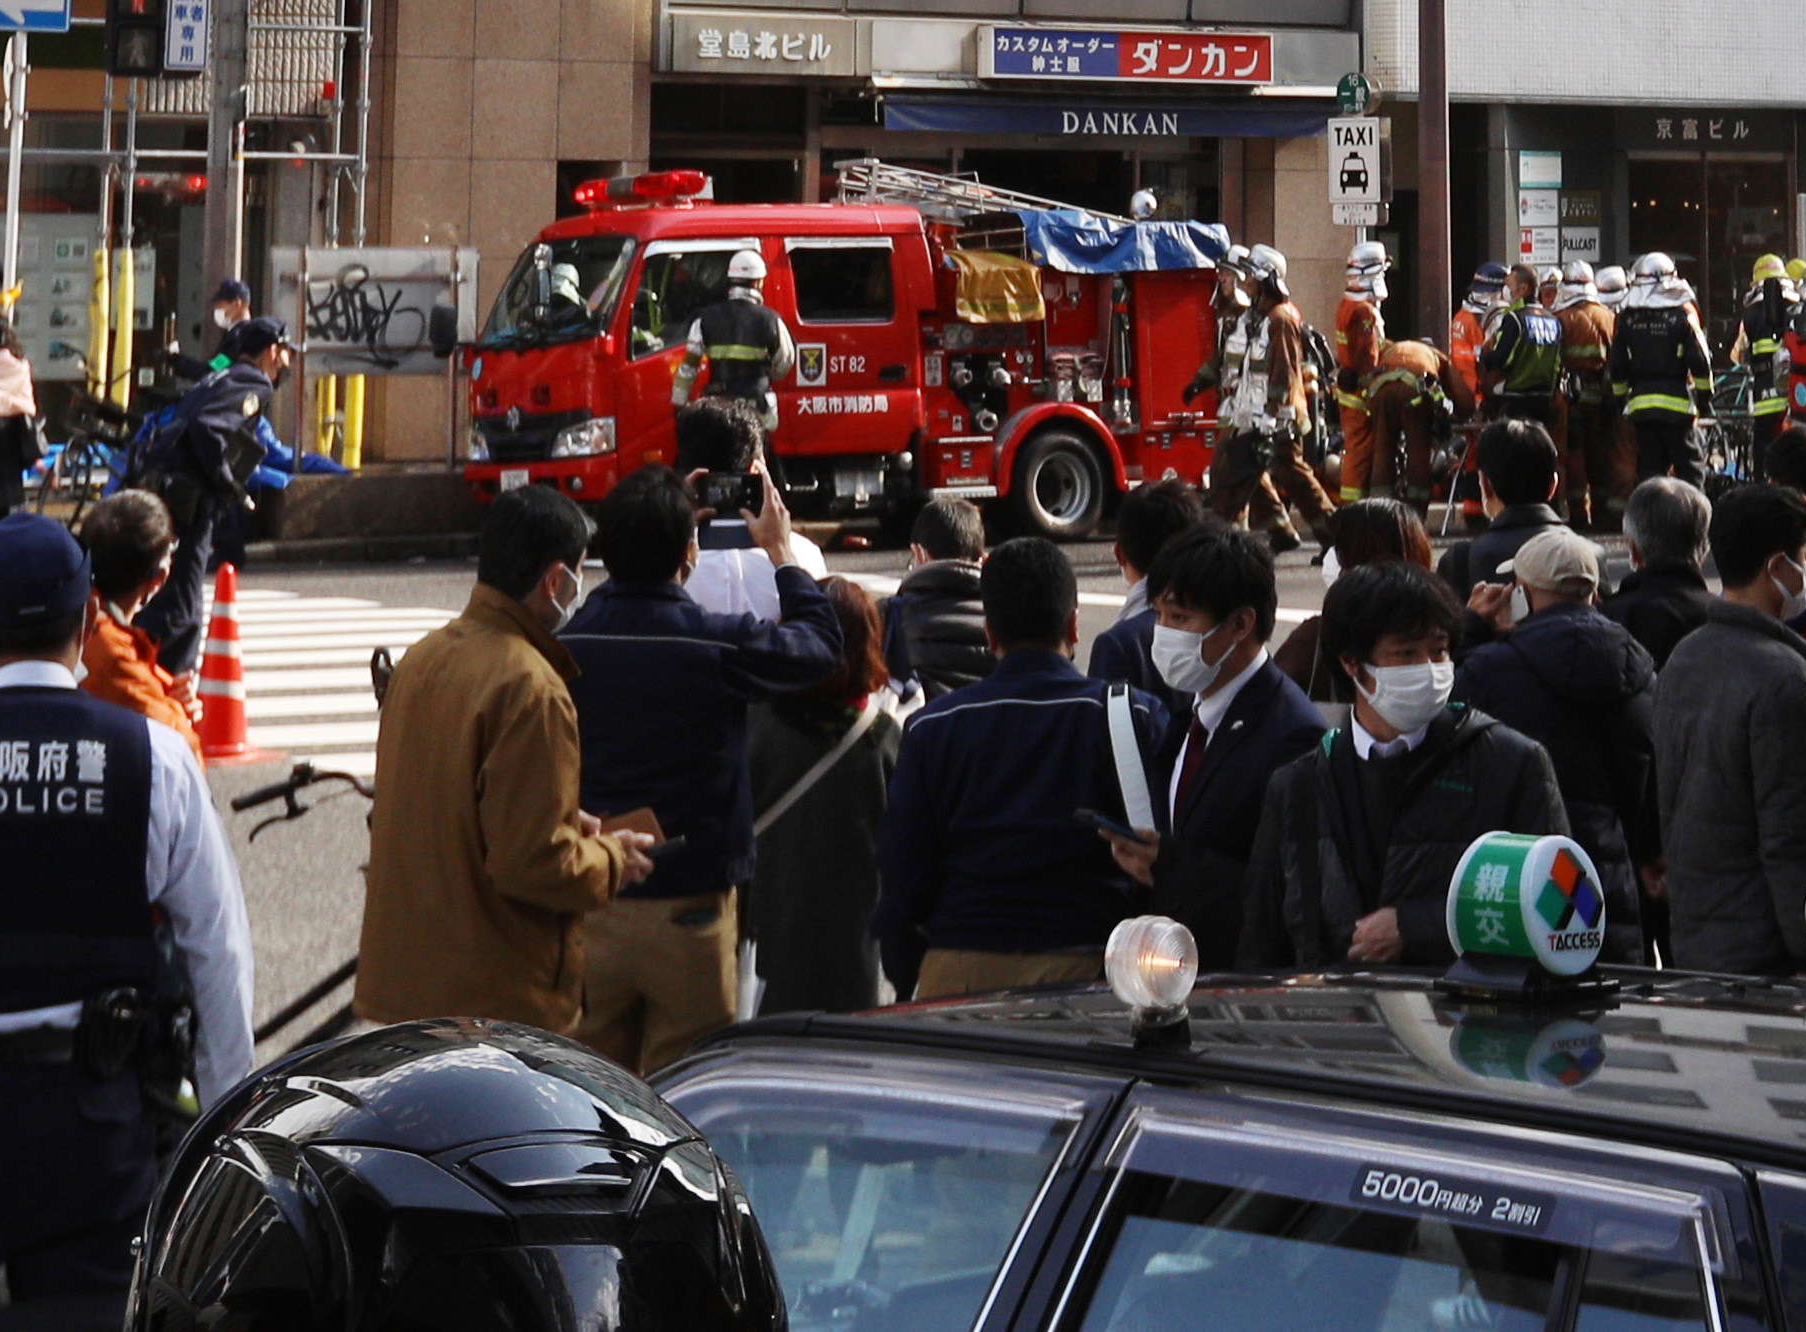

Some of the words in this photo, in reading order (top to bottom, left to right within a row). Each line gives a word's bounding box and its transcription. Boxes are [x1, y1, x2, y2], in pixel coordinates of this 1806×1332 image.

[179, 25, 195, 63] 専用
[697, 29, 833, 62] 堂島北ビル
[996, 35, 1116, 55] カスタムオーダー
[1031, 54, 1082, 74] 紳士服
[1131, 38, 1260, 78] ダンカン
[1062, 110, 1180, 136] DANKAN
[1655, 117, 1750, 140] 京富ビル
[1334, 126, 1373, 146] TAXI
[830, 355, 846, 373] ST
[848, 355, 866, 373] 82
[796, 394, 889, 415] 大阪市消防局
[1548, 931, 1601, 952] TACCESS
[1361, 1169, 1484, 1216] 5000円超分
[1491, 1196, 1542, 1227] 2割引
